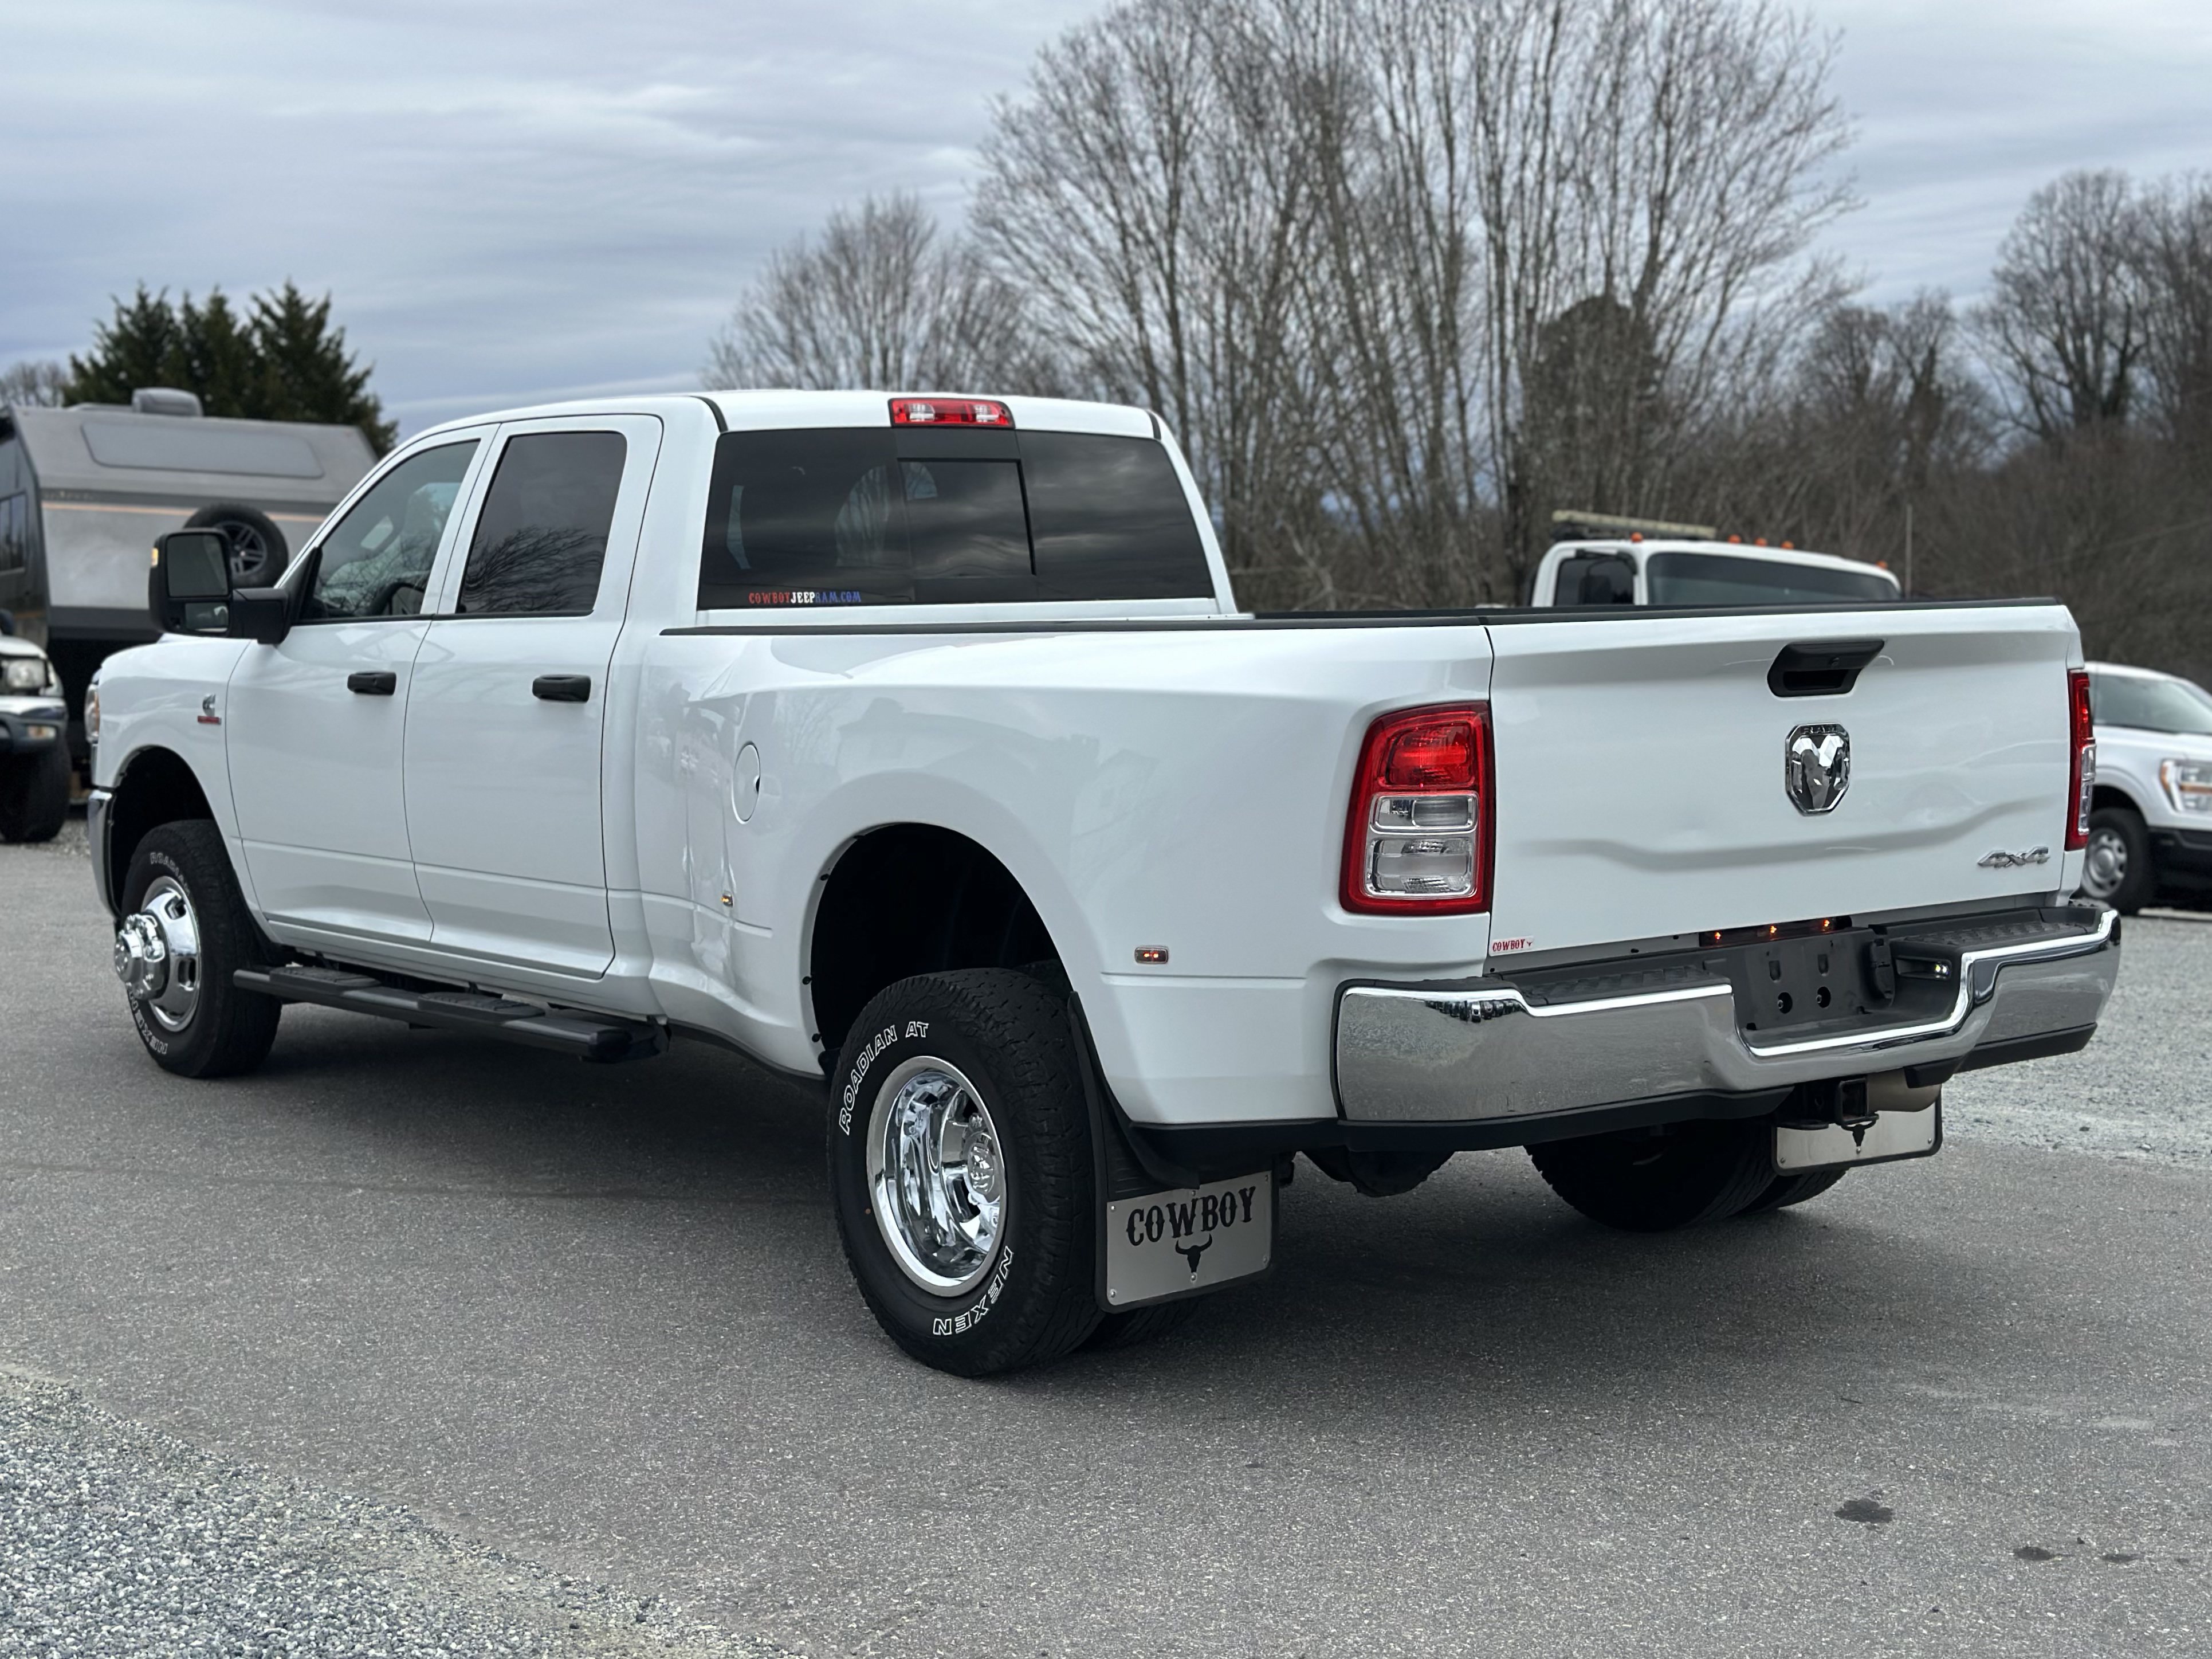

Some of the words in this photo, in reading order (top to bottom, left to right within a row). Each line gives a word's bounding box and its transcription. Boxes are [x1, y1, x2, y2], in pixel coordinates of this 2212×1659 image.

[749, 591, 861, 604] COWBOYJEEPRAM.COM
[1802, 725, 1838, 734] RAM
[1492, 939, 1525, 952] COWBOY
[839, 1025, 898, 1136] ROADIAN
[905, 1021, 929, 1038] AT
[1126, 1186, 1256, 1246] COWBOY
[933, 1245, 1013, 1335] NEXEN
